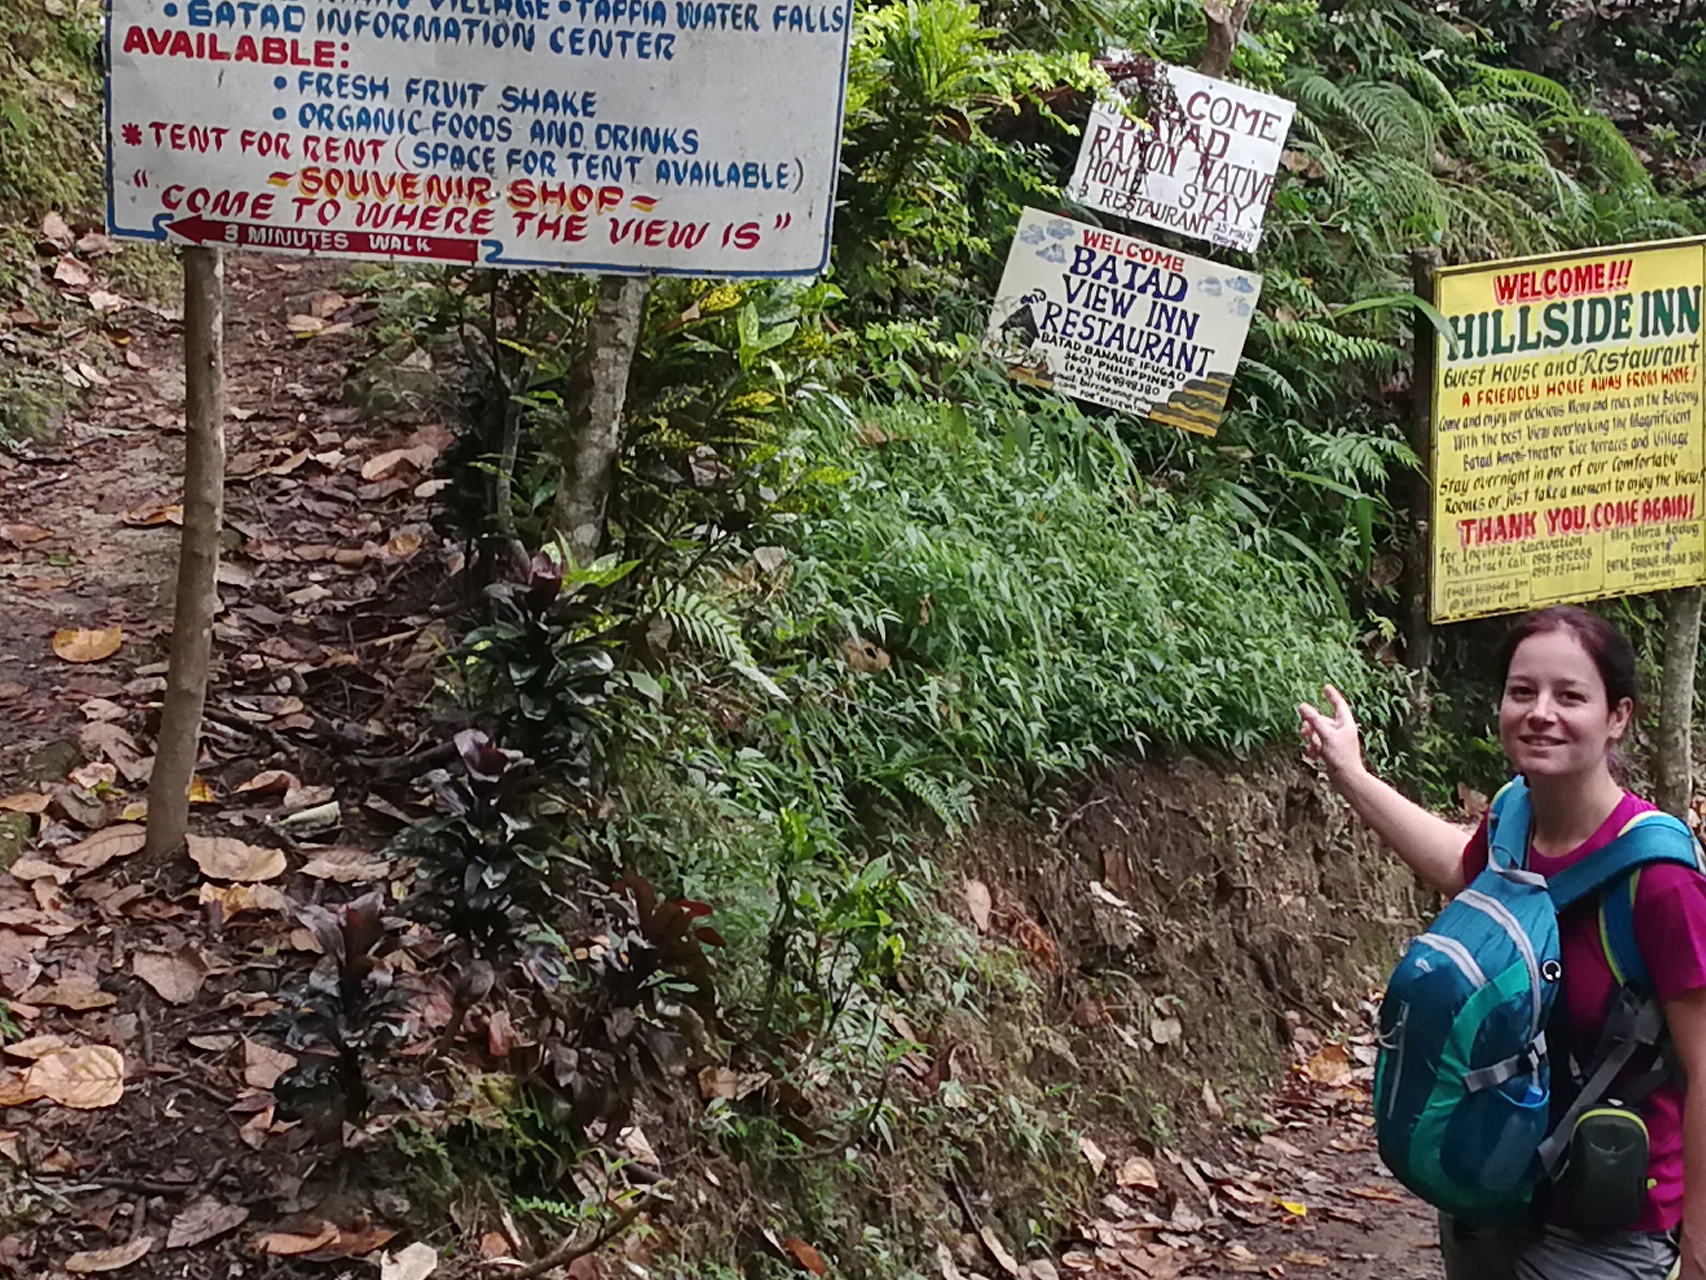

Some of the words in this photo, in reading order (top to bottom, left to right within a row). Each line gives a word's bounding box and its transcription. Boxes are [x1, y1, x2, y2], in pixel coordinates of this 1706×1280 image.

[316, 7, 536, 53] INFORMATION
[549, 26, 676, 60] CENTER
[675, 1, 760, 32] WATER
[773, 4, 844, 34] FALLS
[123, 26, 350, 69] AVAILABLE:
[298, 71, 389, 101] FRESH
[405, 77, 487, 110] FRUIT
[500, 86, 597, 118] SHAKE
[298, 102, 422, 135] ORGANIC
[432, 110, 512, 142] FOODS
[529, 119, 584, 150] AND
[595, 123, 699, 155] DRINKS
[149, 121, 230, 154] TENT
[240, 129, 292, 160] FOR
[302, 135, 389, 166] RENT
[395, 135, 496, 172] (SPACE
[506, 148, 557, 178] FOR
[567, 152, 645, 182] TENT
[656, 157, 804, 194] AVAILABLE)
[299, 166, 492, 207] SOUVENIR
[506, 178, 624, 215] SHOP
[1100, 188, 1212, 235] RESTAURANT
[1178, 183, 1255, 226] STAY
[224, 225, 239, 242] 3
[248, 227, 349, 250] MINUTES
[369, 235, 432, 253] WALK
[292, 196, 340, 226] TO
[355, 201, 496, 236] WHERE
[512, 211, 589, 242] THE
[609, 218, 710, 249] VIEW
[1069, 244, 1189, 303] BATAD
[1083, 229, 1186, 273] WELCOME
[1495, 259, 1633, 304] WELCOME!!!
[1062, 273, 1137, 320] VIEW
[1145, 301, 1201, 341] INN
[1447, 292, 1633, 361] HILLSIDE
[1639, 285, 1701, 338] INN
[1039, 301, 1215, 377] RESTAURANT
[1444, 365, 1486, 389] Guest
[1492, 362, 1539, 383] House
[1544, 353, 1578, 378] and
[1580, 338, 1700, 376] Restaurant
[1462, 392, 1471, 409] A
[1477, 384, 1540, 407] FRIENDLY
[1547, 379, 1584, 397] HOME
[1591, 374, 1622, 393] AWAY
[1626, 370, 1658, 388] FROM
[1459, 510, 1538, 545] THANK
[1593, 499, 1638, 528] COME
[1642, 493, 1696, 521] AGAIN!
